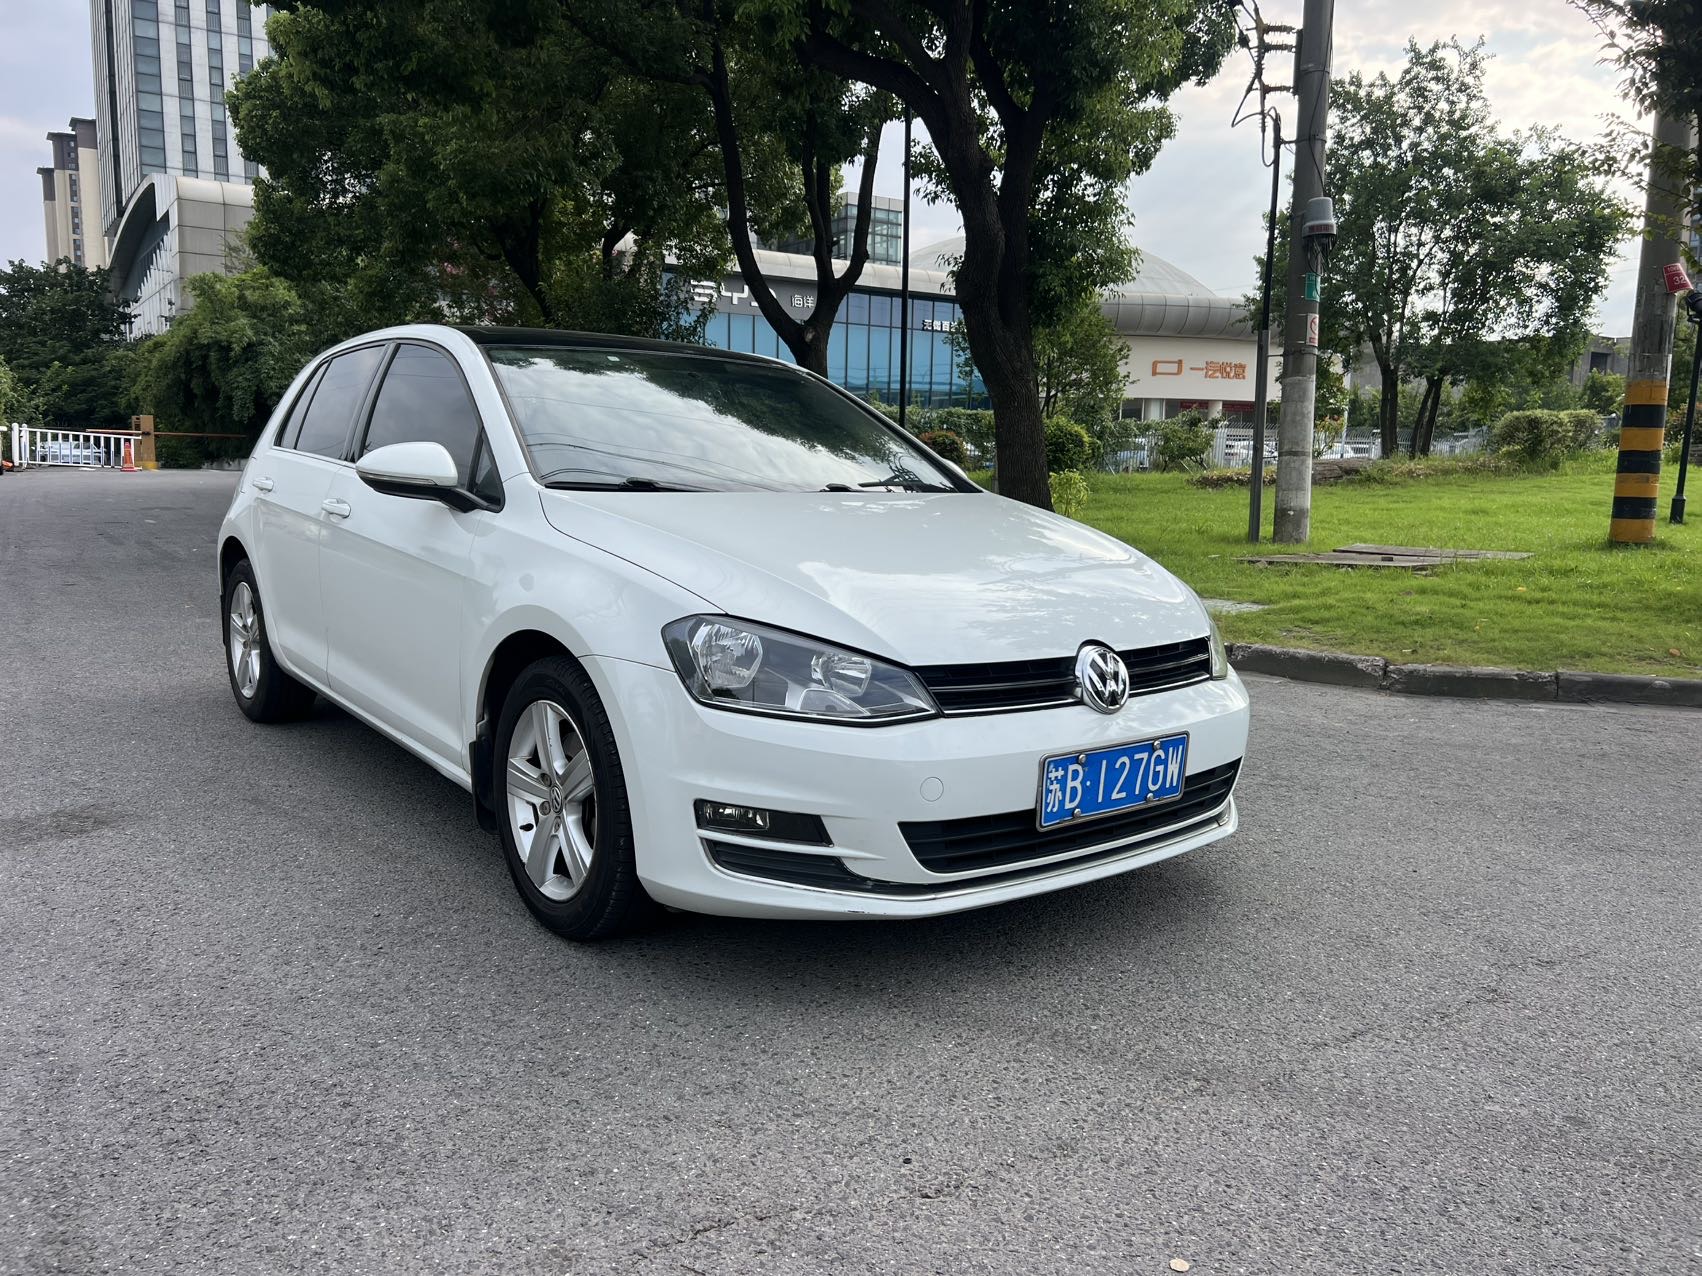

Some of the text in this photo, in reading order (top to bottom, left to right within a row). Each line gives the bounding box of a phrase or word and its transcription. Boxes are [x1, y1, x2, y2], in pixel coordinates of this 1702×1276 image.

[1674, 275, 1686, 284] 32
[690, 280, 814, 308] BY 海洋
